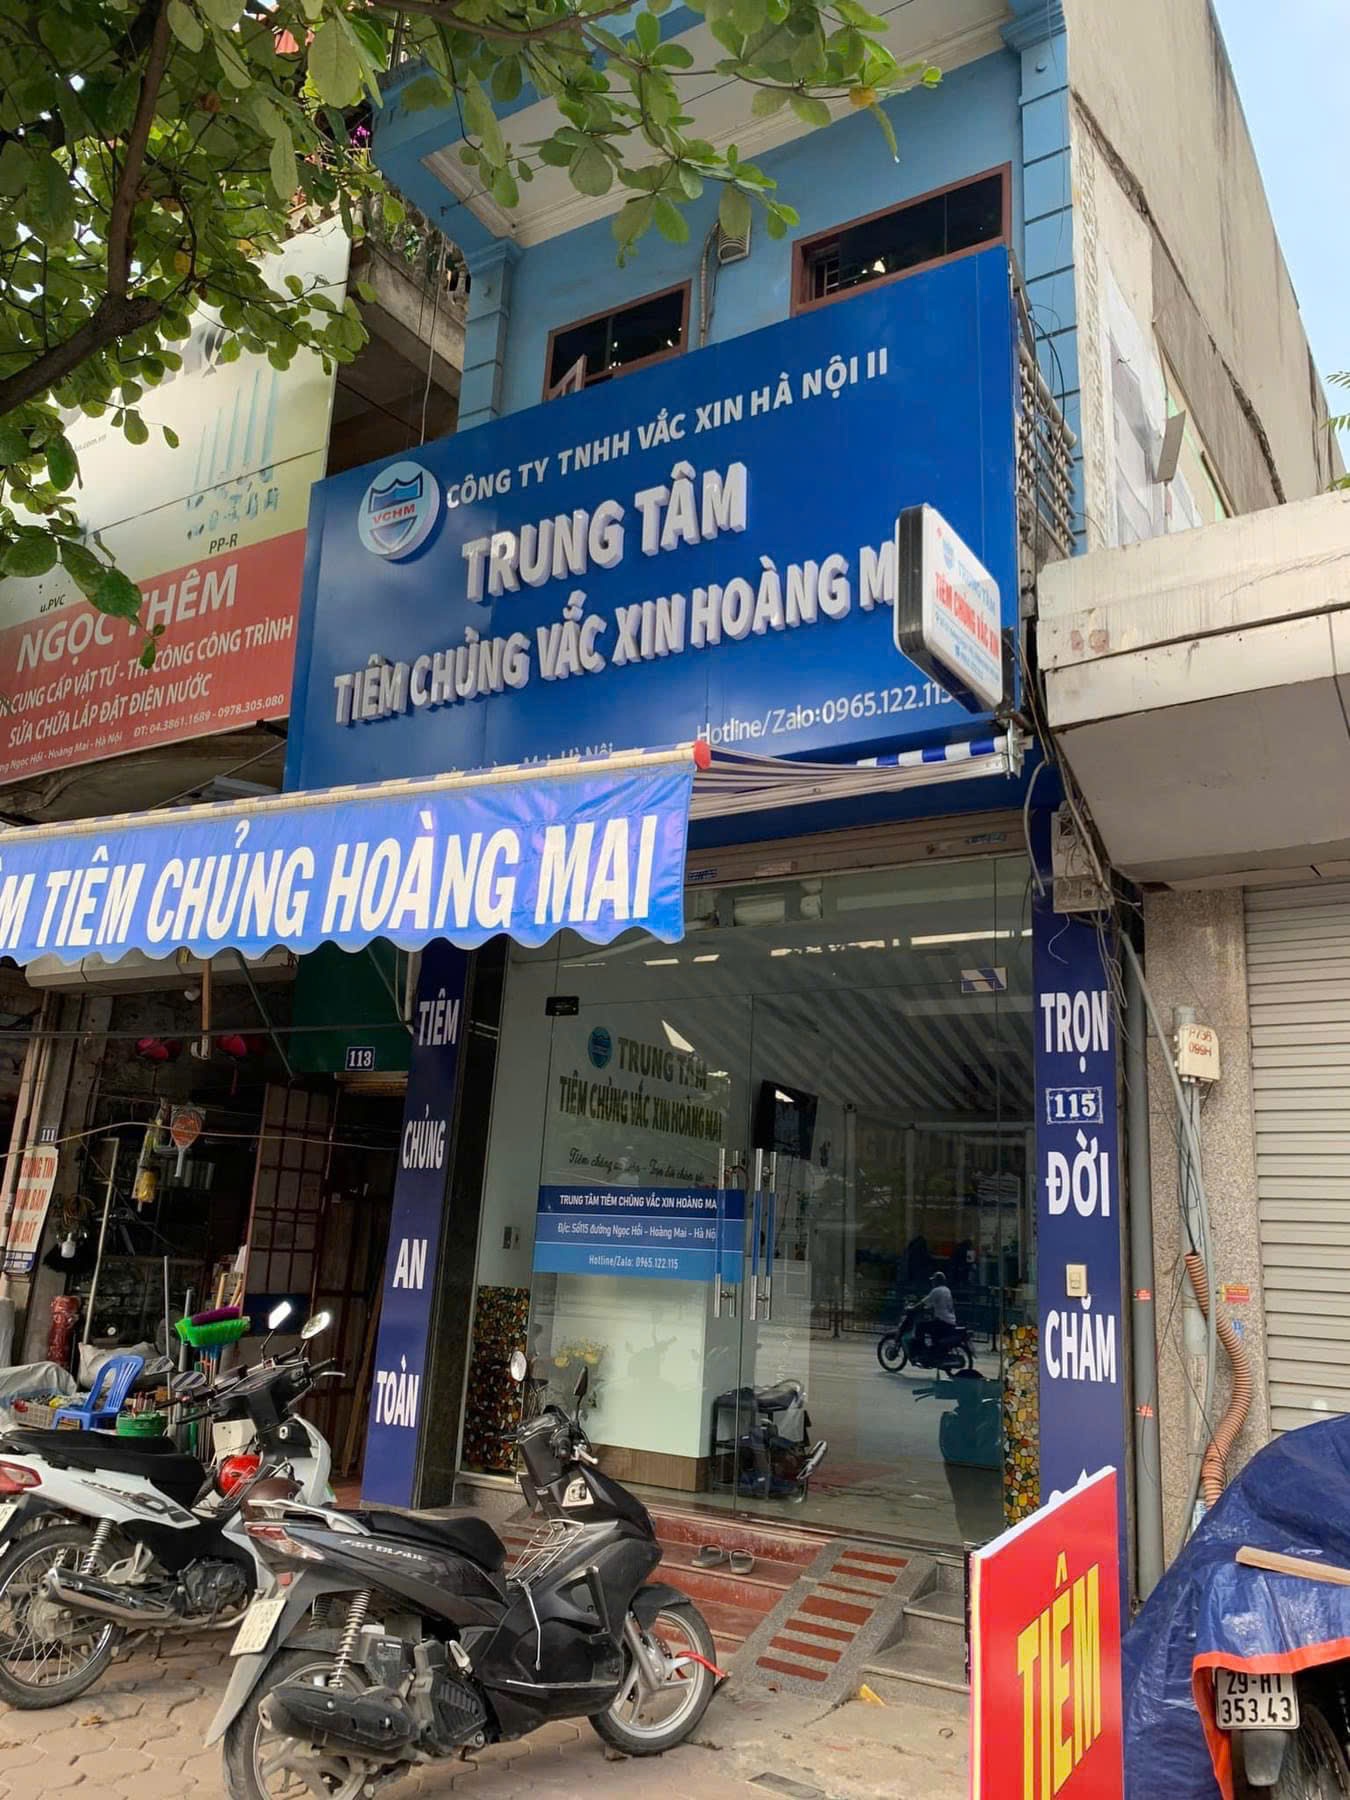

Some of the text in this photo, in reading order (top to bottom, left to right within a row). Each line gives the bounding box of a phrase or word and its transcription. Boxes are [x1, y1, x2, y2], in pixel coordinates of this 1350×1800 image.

[446, 347, 889, 510] CÔNG TY TNHH VẮC XIN HÀ NỘI II
[372, 503, 416, 524] VCHM
[461, 459, 750, 603] TRUNG TÂM
[208, 533, 238, 554] PP-R
[11, 686, 46, 715] CUNG
[47, 672, 73, 704] CẤP
[74, 668, 98, 699] VẬT
[100, 661, 120, 688] TƯ
[153, 641, 194, 673] CÔNG
[197, 629, 242, 660] CÔNG
[245, 615, 294, 648] TRÌNH
[334, 653, 408, 726] TIÊM
[409, 625, 531, 702] CHỦNG
[536, 588, 606, 682] VẮC
[611, 592, 687, 667] XIN
[691, 554, 852, 650] HOÀNG
[8, 672, 212, 748] SỬA CHỮA LẮP ĐẶT ĐIỆN NƯỚC
[74, 740, 90, 753] Mai
[217, 694, 285, 718] 0978.305.080
[36, 845, 147, 948] TIÊM
[146, 819, 316, 944] CHỦNG
[321, 810, 520, 933] HOÀNG
[534, 815, 657, 926] MAI
[418, 988, 461, 1046] TIÊM
[1040, 990, 1109, 1073] TRỌN
[349, 1051, 372, 1068] 113
[618, 1036, 674, 1083] TRUNG
[559, 1069, 588, 1118] TIÊM
[589, 1076, 629, 1125] CHỦNG
[652, 1096, 670, 1135] XIN
[670, 1095, 705, 1140] HOÀNG
[1053, 1092, 1097, 1119] 115
[41, 1129, 54, 1142] 111
[402, 1104, 447, 1170] CHỦNG
[560, 1194, 583, 1206] TRUNG
[584, 1192, 600, 1206] TÂM
[600, 1193, 618, 1207] TIÊM
[618, 1193, 644, 1208] CHỦNG
[646, 1191, 660, 1208] VẮC
[661, 1197, 675, 1209] XIN
[676, 1196, 704, 1210] HOÀNG
[1045, 1128, 1110, 1218] ĐỜI
[589, 1223, 612, 1238] đường
[612, 1224, 631, 1239] Ngọc
[631, 1222, 643, 1236] Hồi
[650, 1225, 672, 1240] Hoàng
[673, 1227, 688, 1238] Mai
[694, 1226, 704, 1239] Hà
[392, 1238, 428, 1290] AN
[588, 1255, 679, 1270] Hotline/Zalo: 0965.122.115
[1044, 1294, 1118, 1384] CHĂM
[1017, 1551, 1102, 1800] TIÊM
[1222, 1696, 1292, 1724] 353.43
